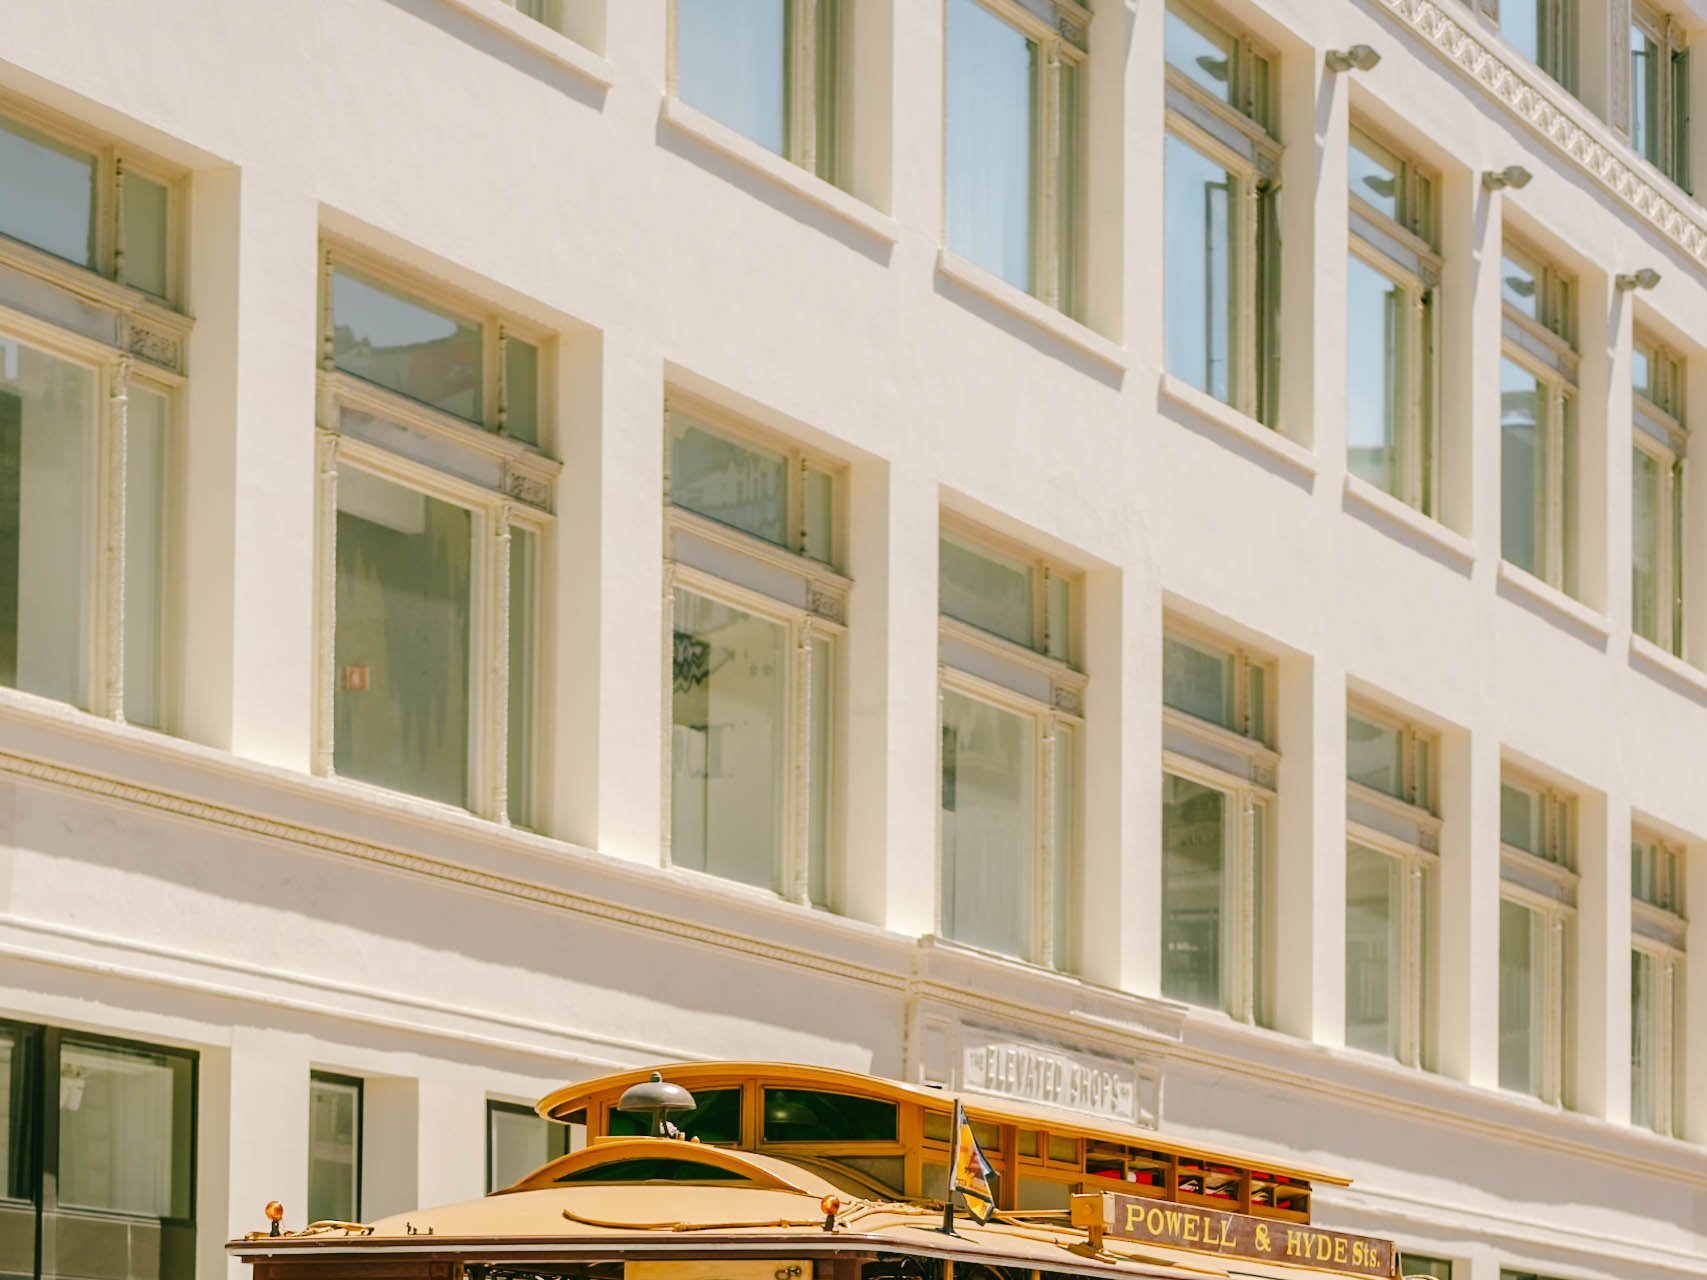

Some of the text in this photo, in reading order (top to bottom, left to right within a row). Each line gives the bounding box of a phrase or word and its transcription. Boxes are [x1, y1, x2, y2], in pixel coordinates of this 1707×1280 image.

[986, 1045, 1062, 1102] ELEVATED
[1069, 1062, 1120, 1113] SHOPS
[1124, 1203, 1381, 1268] POWELL & HYDE Sts.
